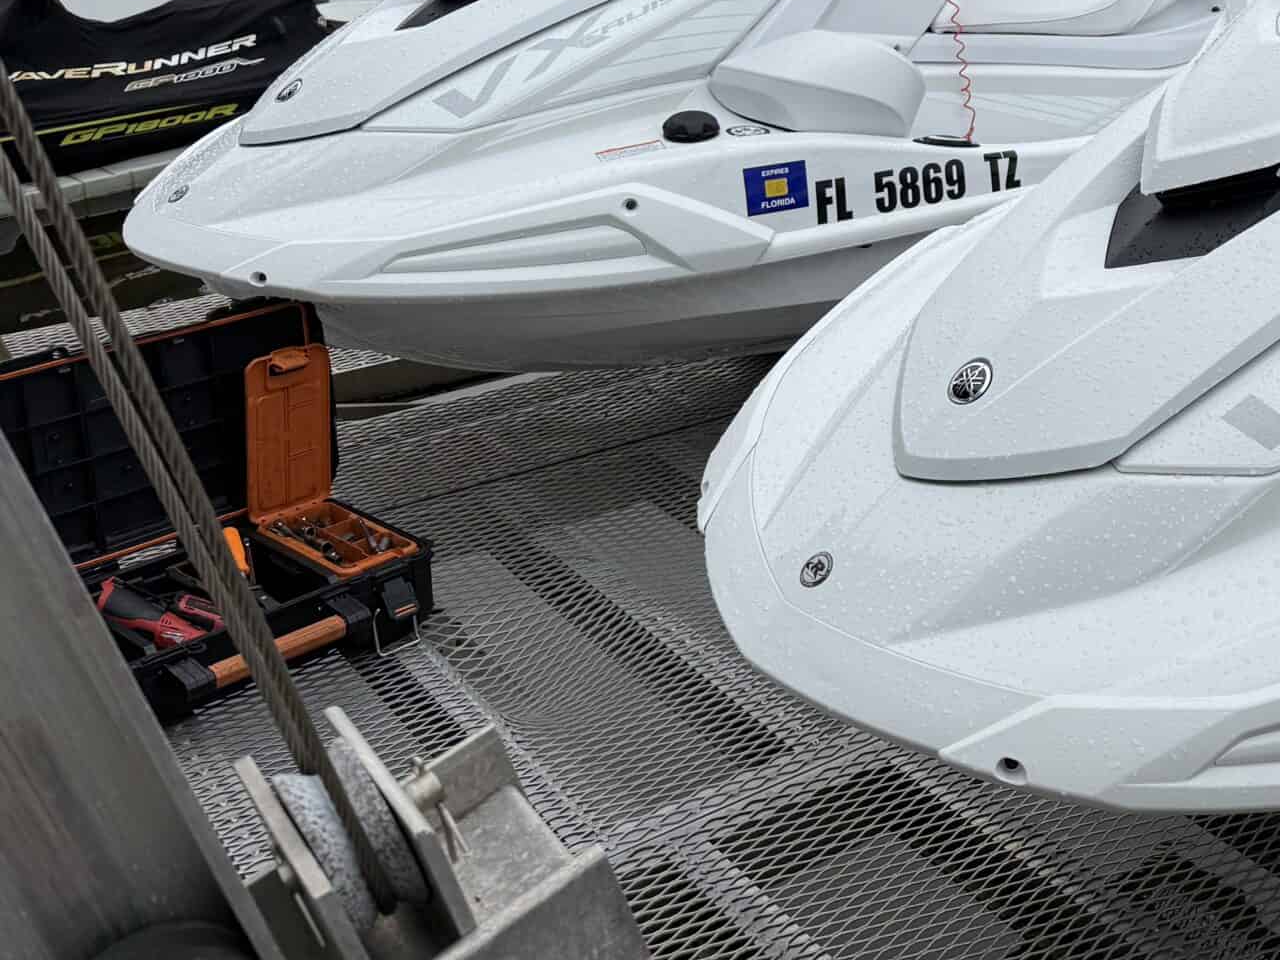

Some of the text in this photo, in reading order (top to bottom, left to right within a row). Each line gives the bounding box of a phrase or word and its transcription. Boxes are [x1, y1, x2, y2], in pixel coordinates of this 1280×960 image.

[432, 14, 612, 119] VX
[60, 103, 239, 147] GP1800R
[761, 197, 796, 209] FLORIDA
[815, 150, 1022, 225] FL 5869 TZ
